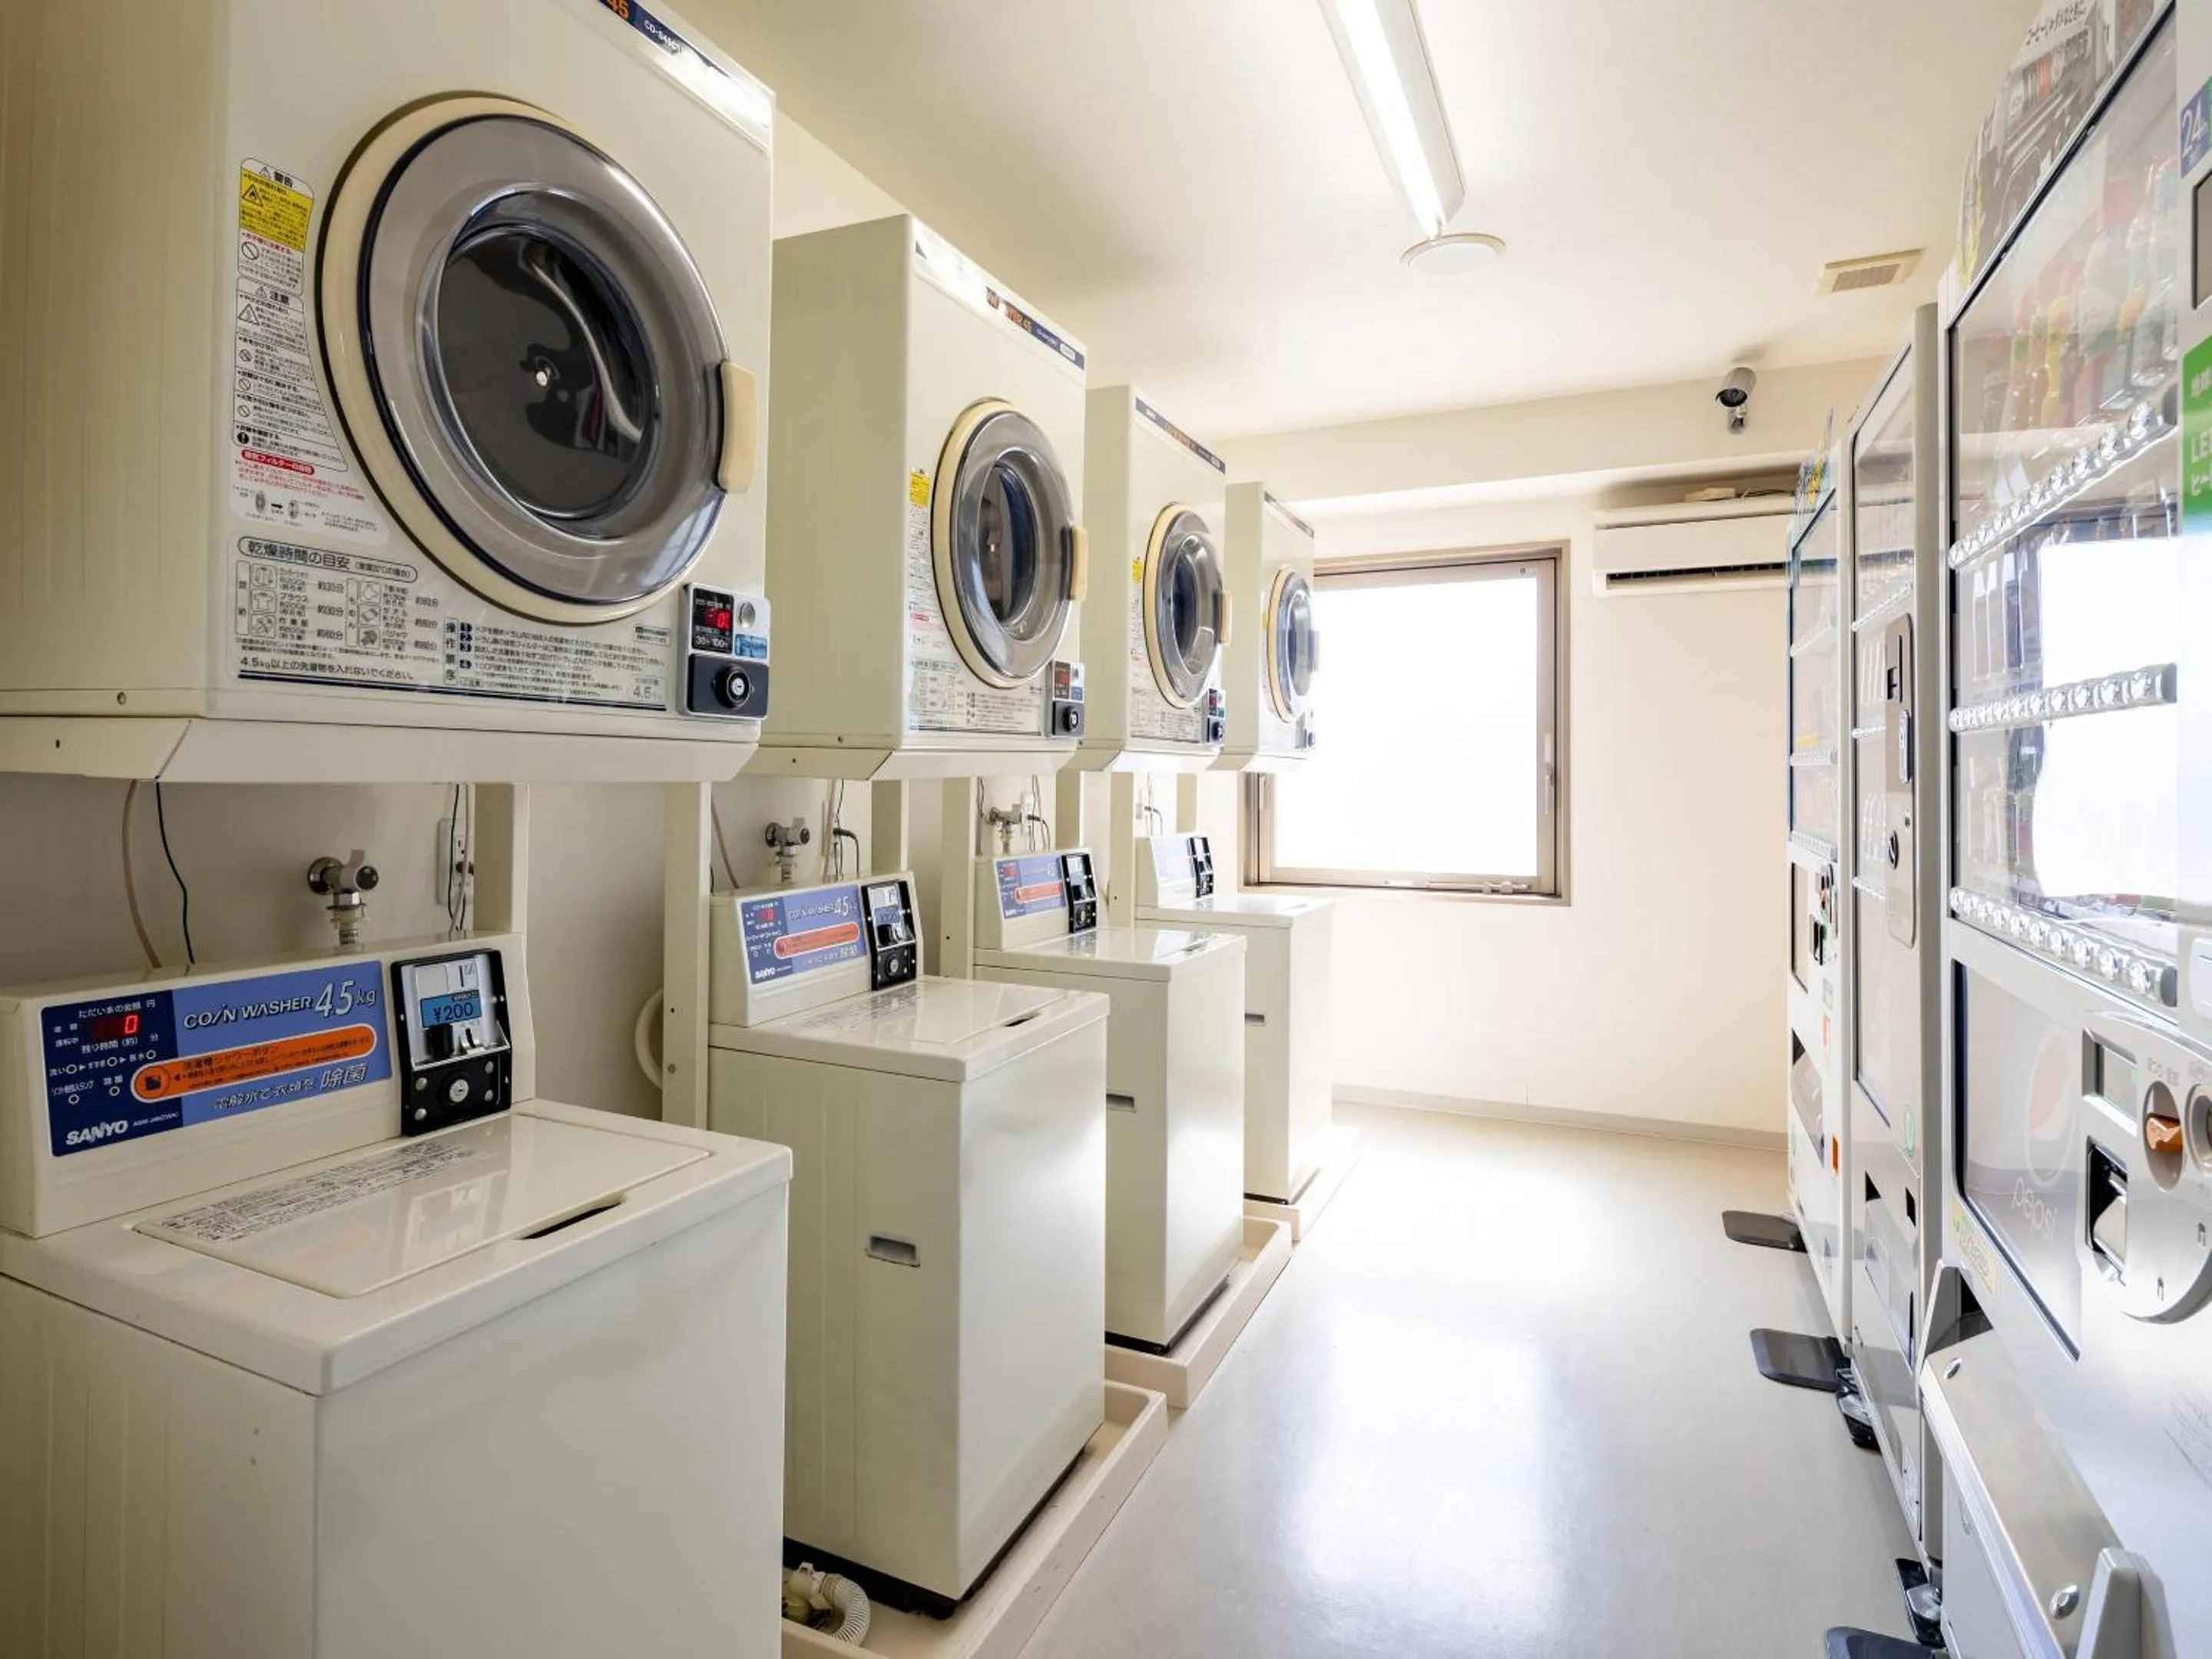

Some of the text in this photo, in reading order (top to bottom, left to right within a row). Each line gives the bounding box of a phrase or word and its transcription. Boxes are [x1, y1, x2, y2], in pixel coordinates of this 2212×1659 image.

[2191, 429, 2212, 463] LE
[248, 540, 350, 570] 乾燥時間の目安
[241, 995, 313, 1020] WASHER
[356, 988, 376, 1007] kg
[433, 1002, 474, 1022] ¥200
[124, 1015, 138, 1035] 0
[320, 1063, 367, 1091] 除菌
[66, 1120, 128, 1145] SANYO
